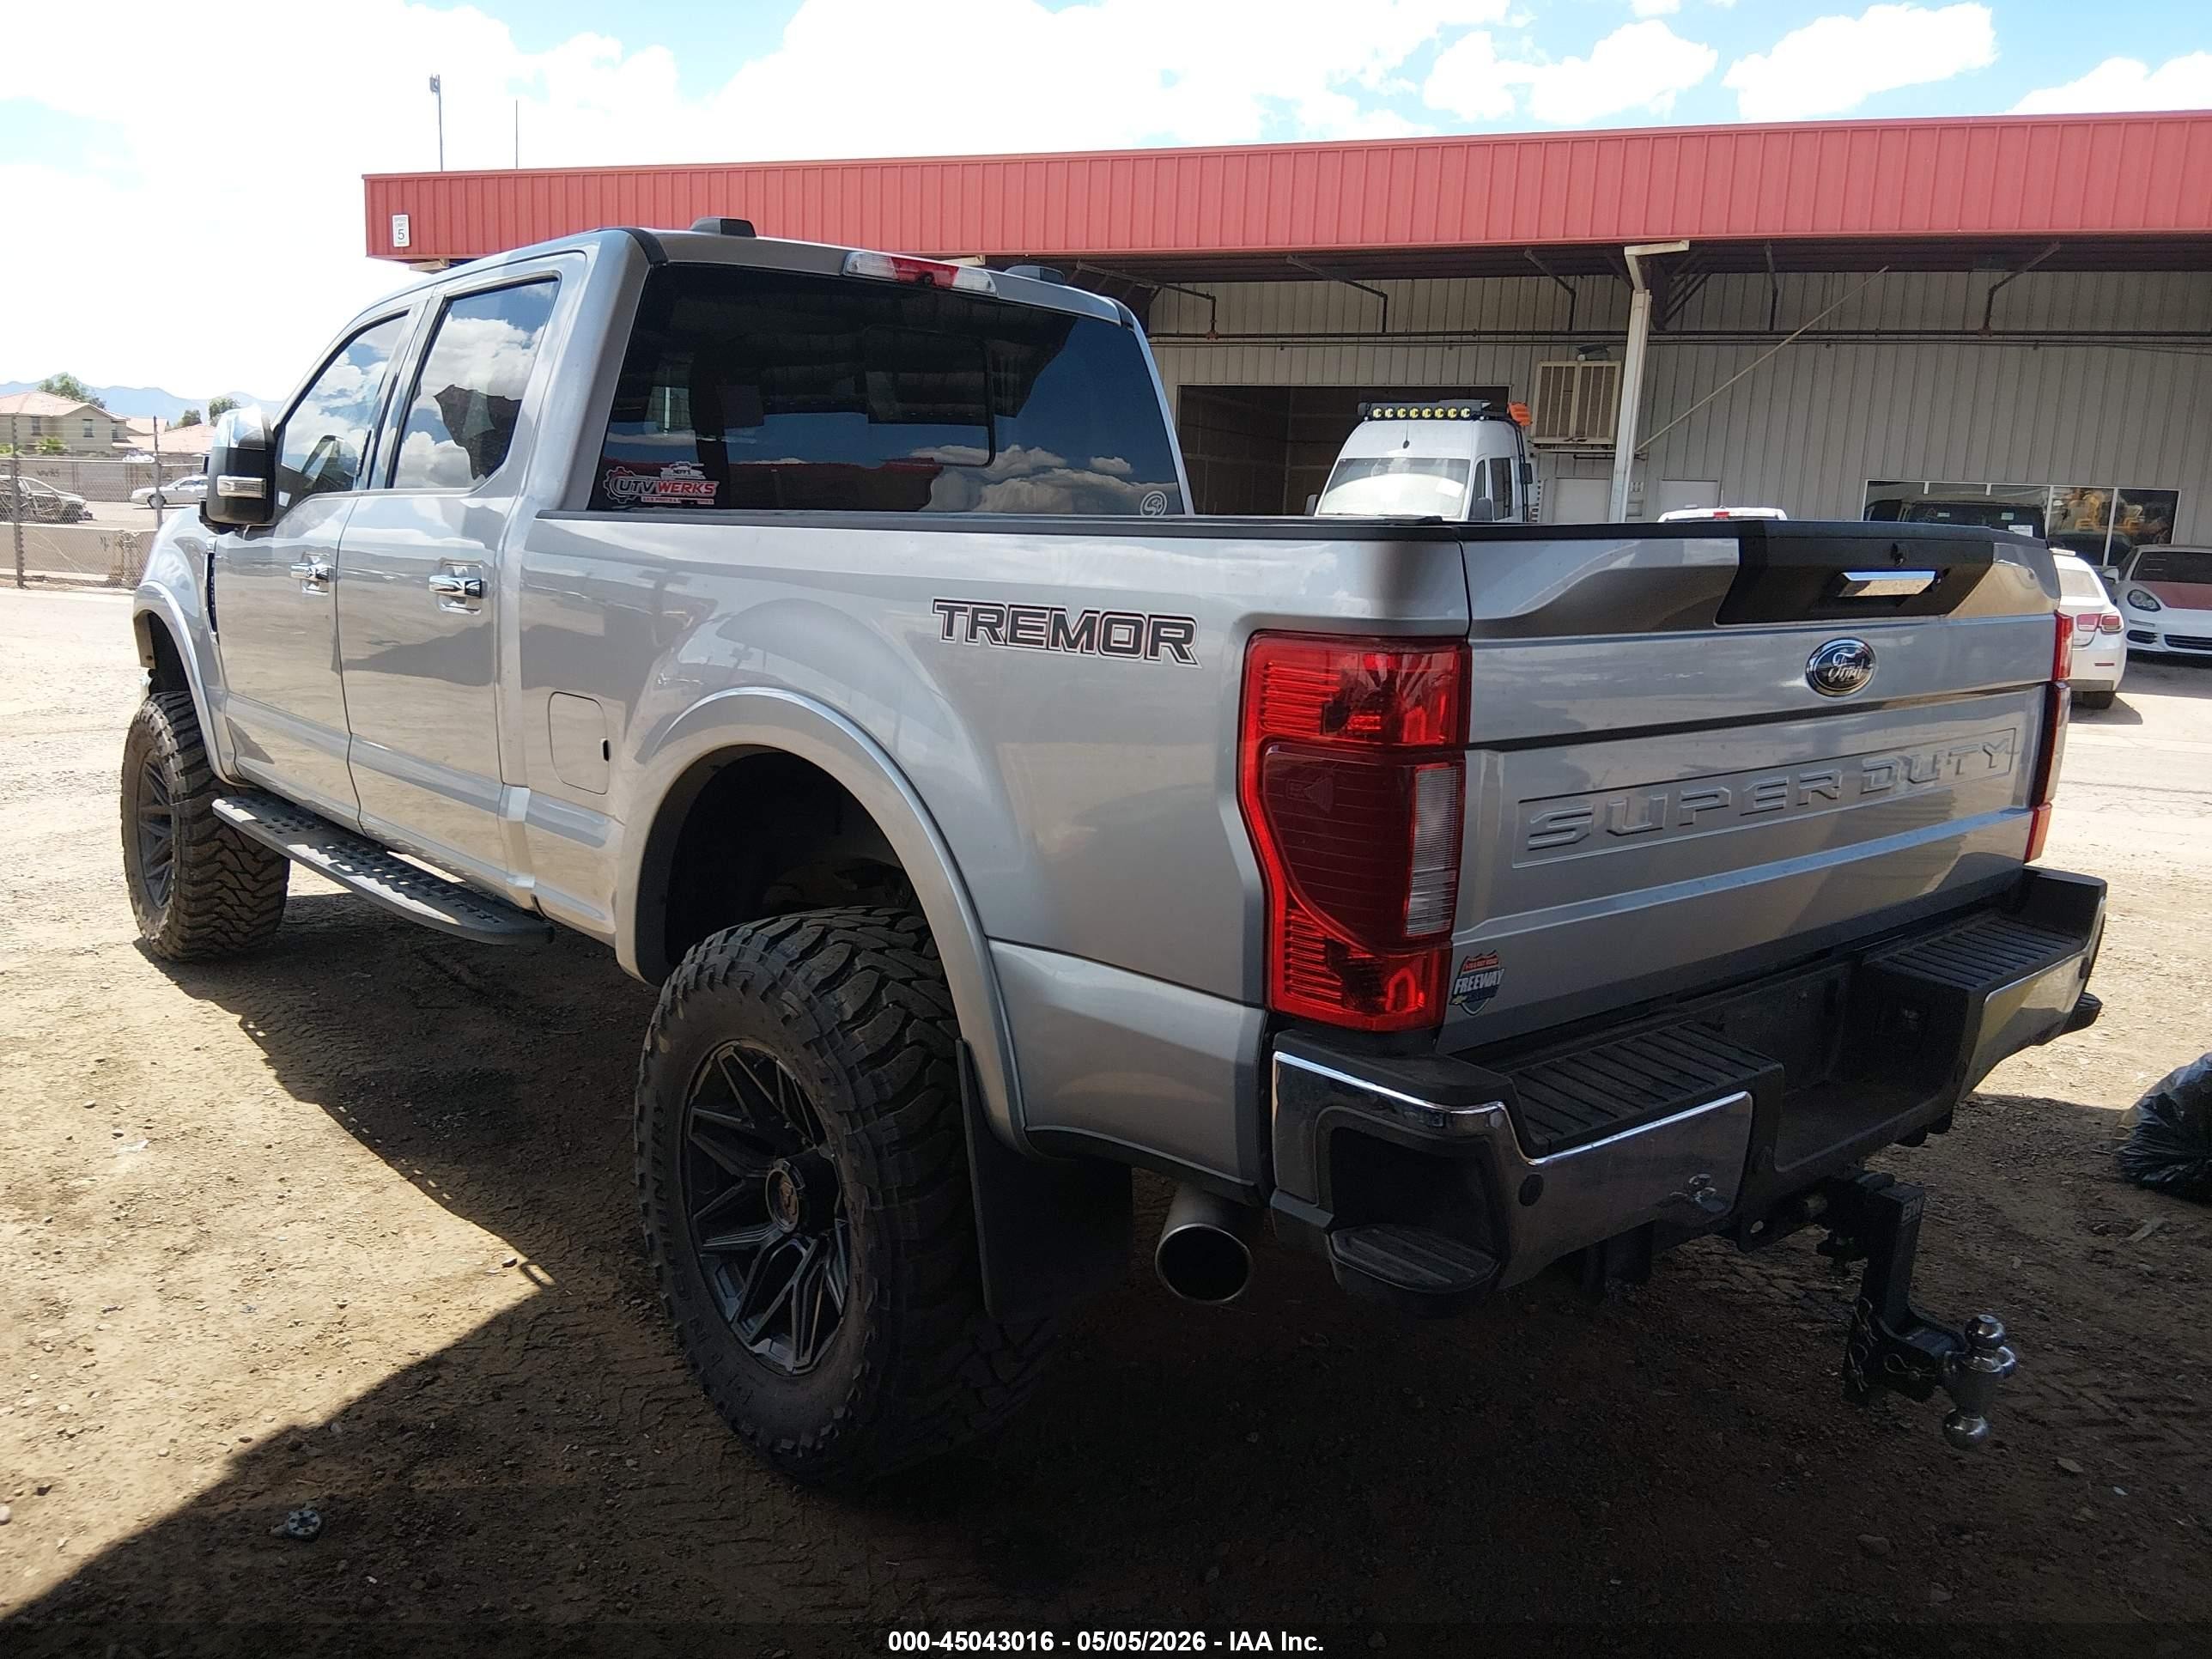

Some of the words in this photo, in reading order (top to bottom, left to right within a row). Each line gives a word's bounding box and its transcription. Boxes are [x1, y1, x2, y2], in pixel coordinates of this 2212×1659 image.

[398, 228, 405, 240] 5
[619, 480, 655, 494] UTV
[658, 482, 715, 495] WERKS
[933, 599, 1198, 665] TREMOR
[1827, 651, 1865, 683] Ford
[1528, 768, 1843, 851] SUPER
[1860, 737, 2012, 795] DUTY
[1454, 969, 1504, 995] FREEWAY
